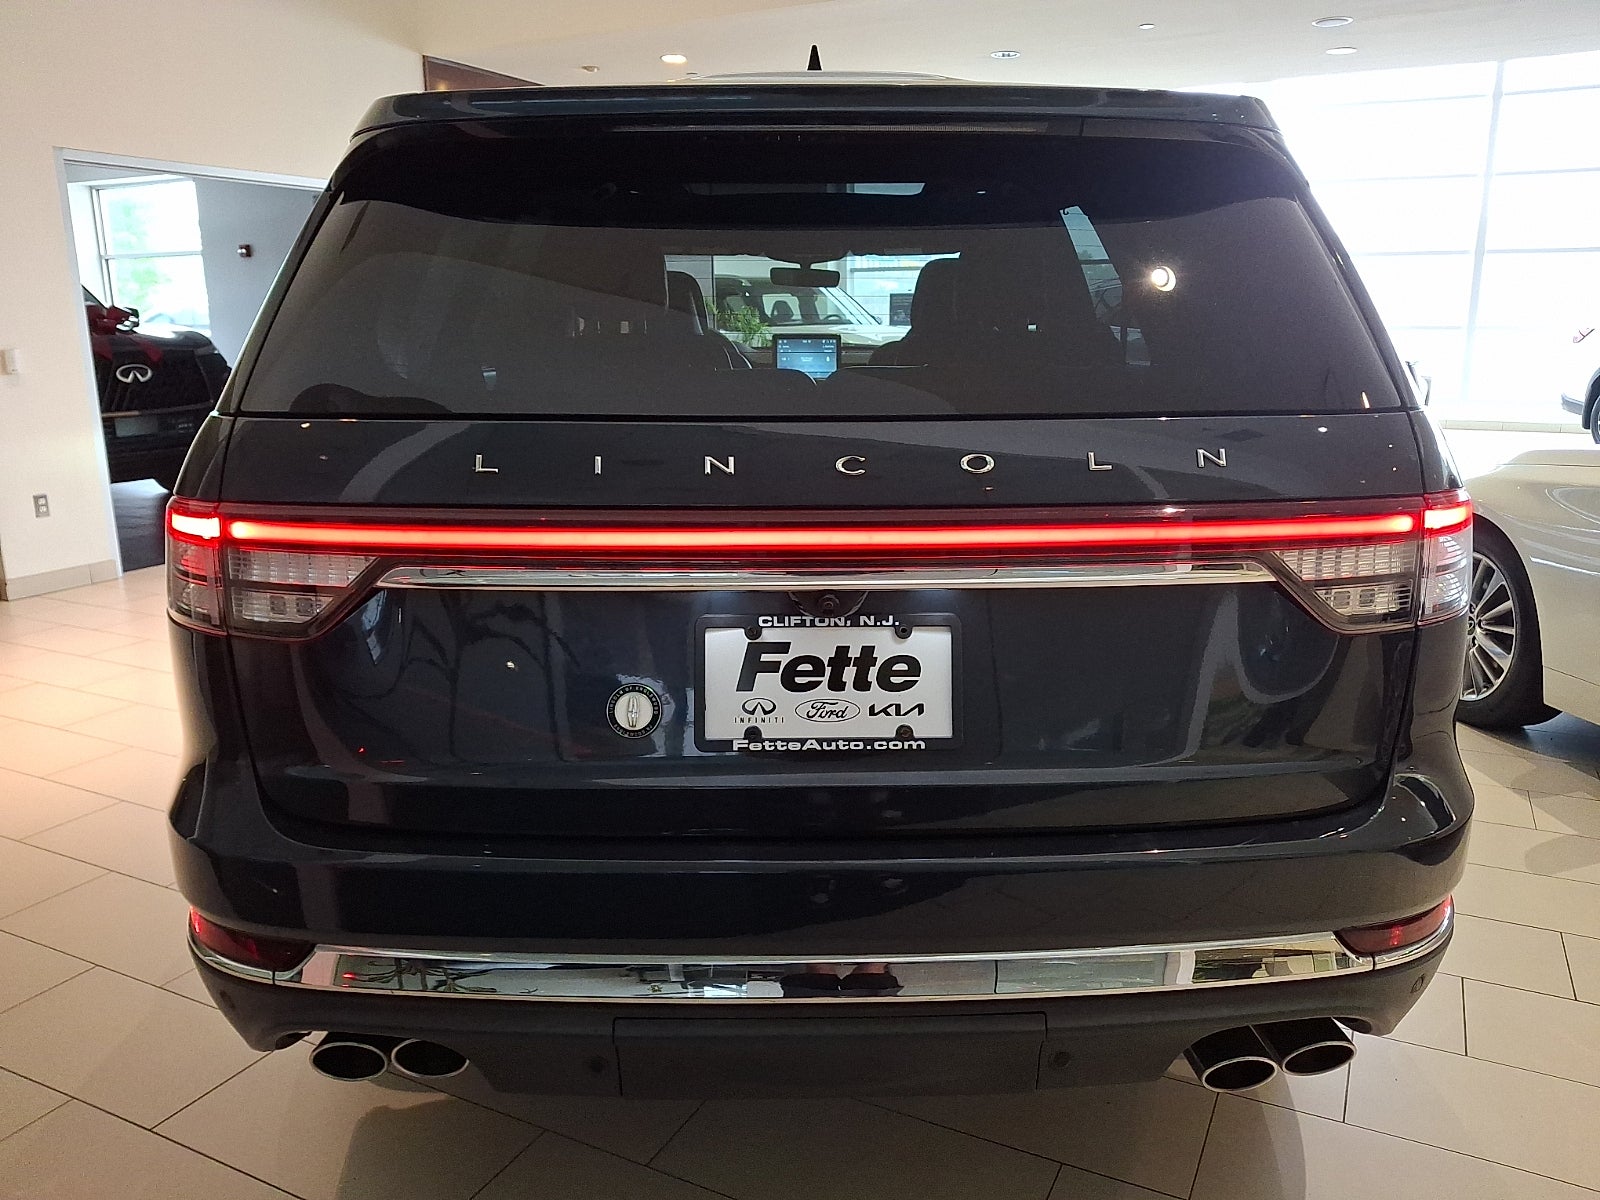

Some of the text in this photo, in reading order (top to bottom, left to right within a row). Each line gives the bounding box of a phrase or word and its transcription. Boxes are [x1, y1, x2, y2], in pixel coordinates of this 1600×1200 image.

[475, 448, 1227, 476] LINCOLN
[758, 614, 900, 627] CLIFTON, N.J.
[735, 641, 922, 693] Fette
[805, 701, 849, 719] Ford
[868, 703, 925, 717] KIA
[734, 716, 785, 724] INFINITI
[732, 739, 926, 751] FetteAuto.com
